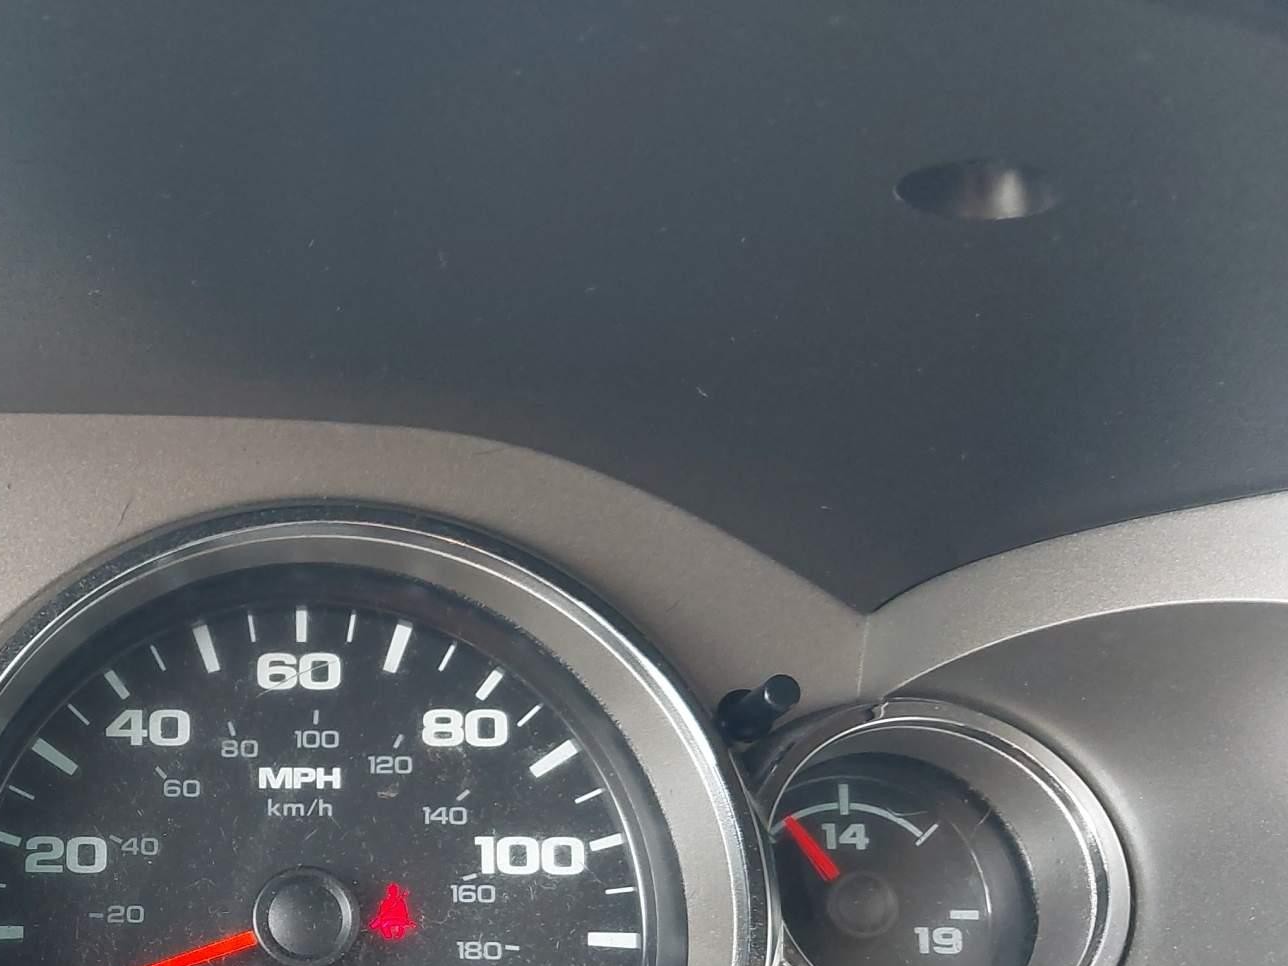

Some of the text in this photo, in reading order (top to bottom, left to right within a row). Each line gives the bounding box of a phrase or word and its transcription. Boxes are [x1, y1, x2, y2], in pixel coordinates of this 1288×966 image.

[256, 653, 341, 690] 60
[106, 708, 190, 746] 40
[421, 708, 508, 747] 80
[294, 729, 340, 749] 100
[220, 740, 259, 759] 80
[368, 755, 413, 775] 120
[163, 779, 201, 798] 60
[258, 767, 342, 790] MPH
[266, 799, 333, 820] km/h
[422, 806, 468, 826] 140
[120, 837, 159, 856] 40
[822, 823, 869, 850] 14
[25, 836, 107, 874] 20
[474, 836, 584, 875] 100
[450, 884, 496, 903] 160
[104, 905, 144, 924] 20
[456, 941, 502, 960] 180
[914, 926, 963, 955] 19
